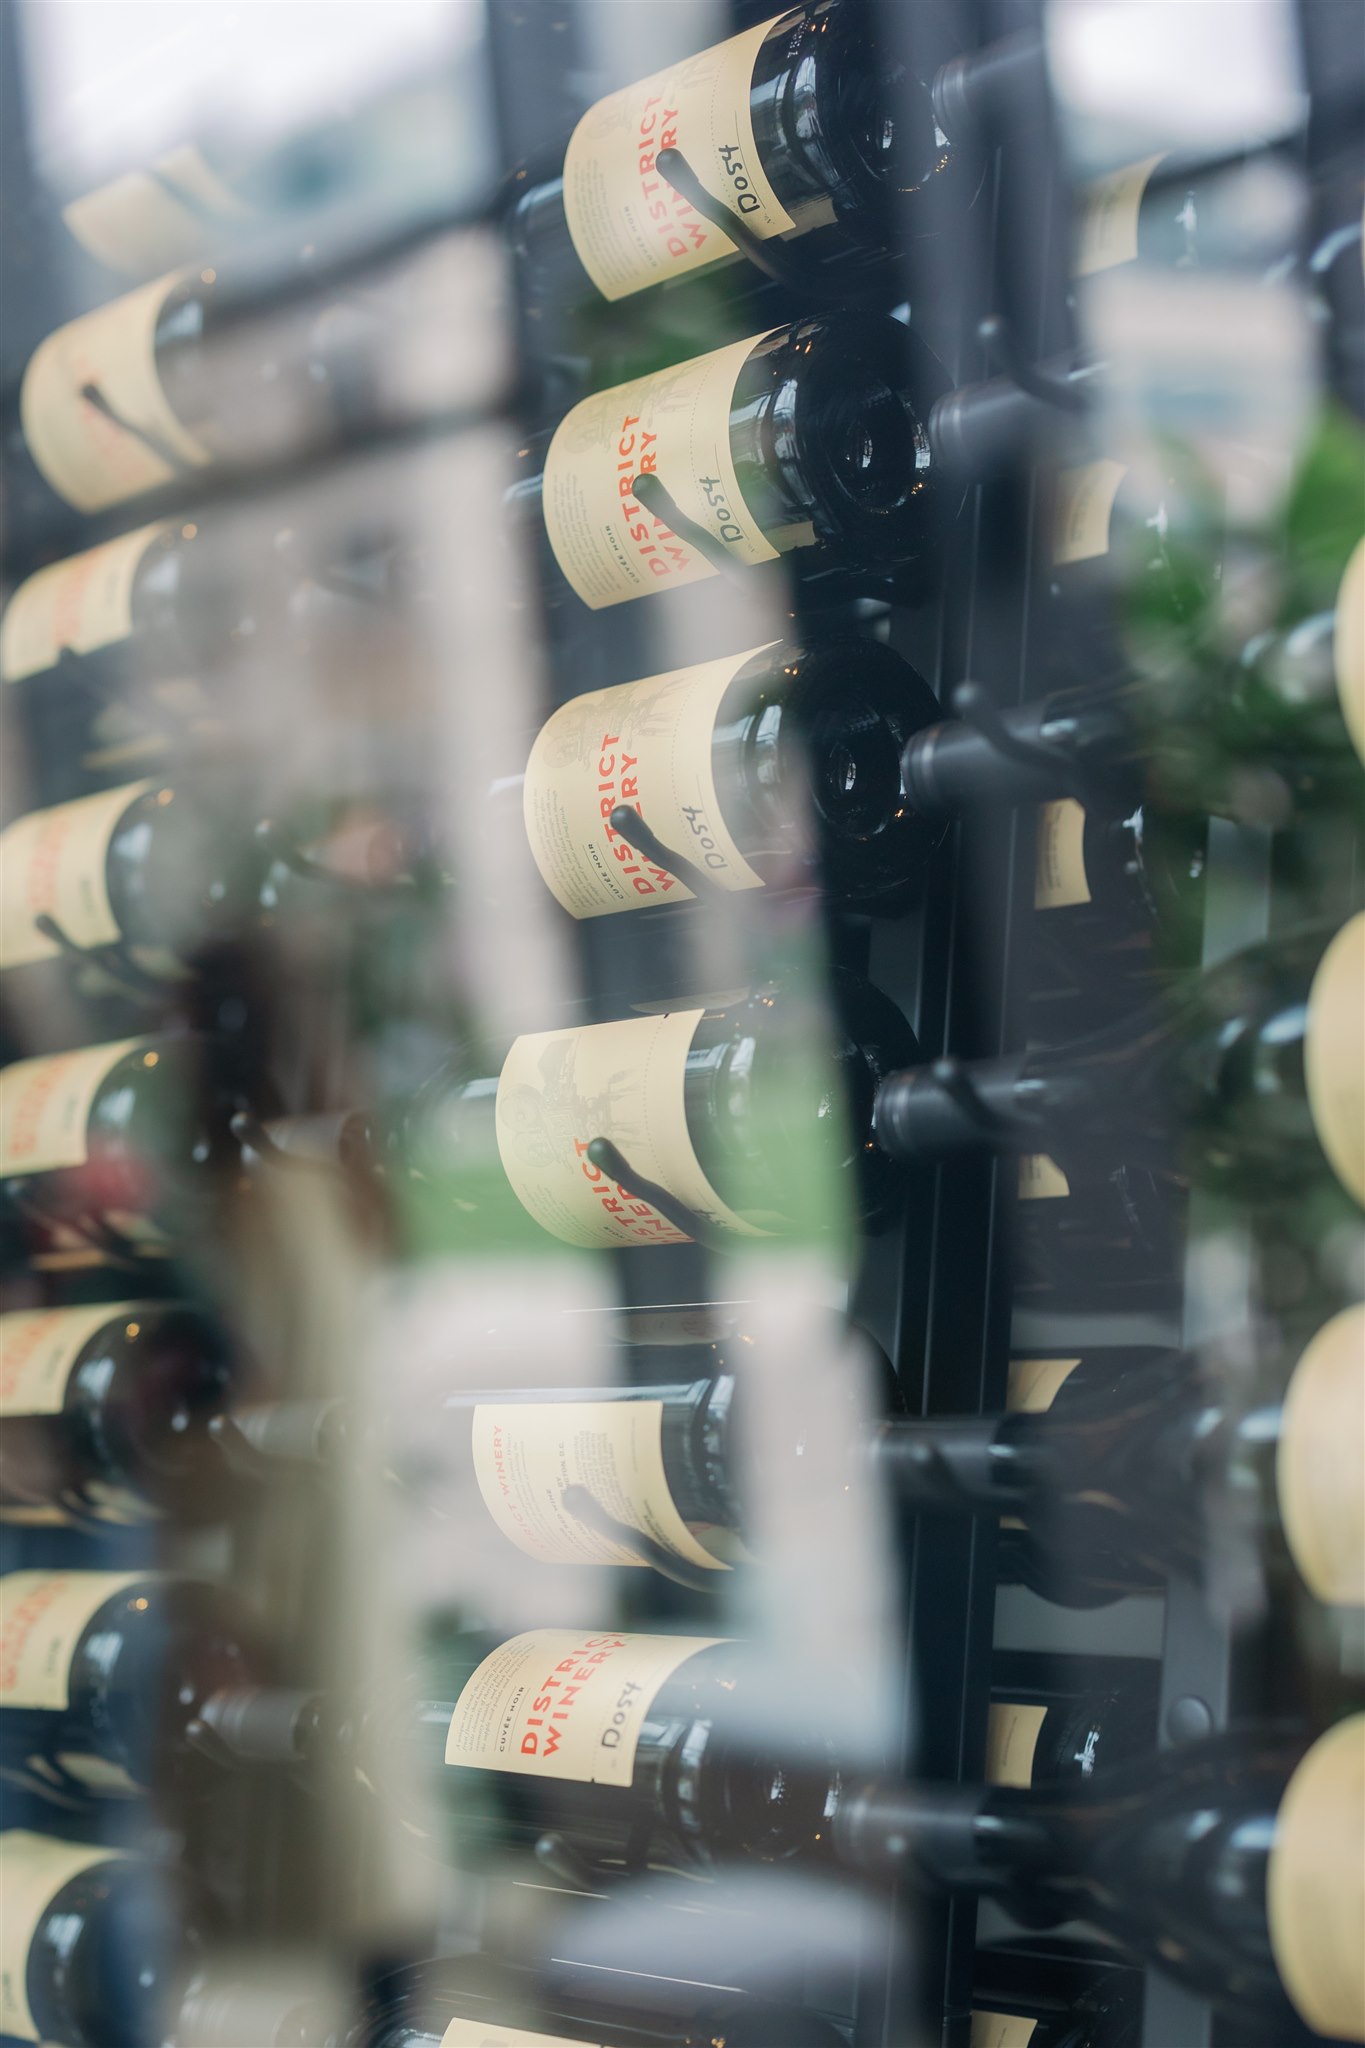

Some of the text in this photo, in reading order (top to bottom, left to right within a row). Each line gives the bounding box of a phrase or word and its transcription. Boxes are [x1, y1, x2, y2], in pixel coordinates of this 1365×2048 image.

[638, 96, 689, 258] DISTRICT
[618, 415, 672, 577] DISTRICT
[586, 842, 602, 869] NOIR
[598, 734, 656, 895] DISTRICT
[493, 1424, 510, 1496] WINERY
[499, 1686, 525, 1753] CUVÉE NOIR
[520, 1633, 625, 1755] DISTRICT
[542, 1640, 627, 1757] WINERY
